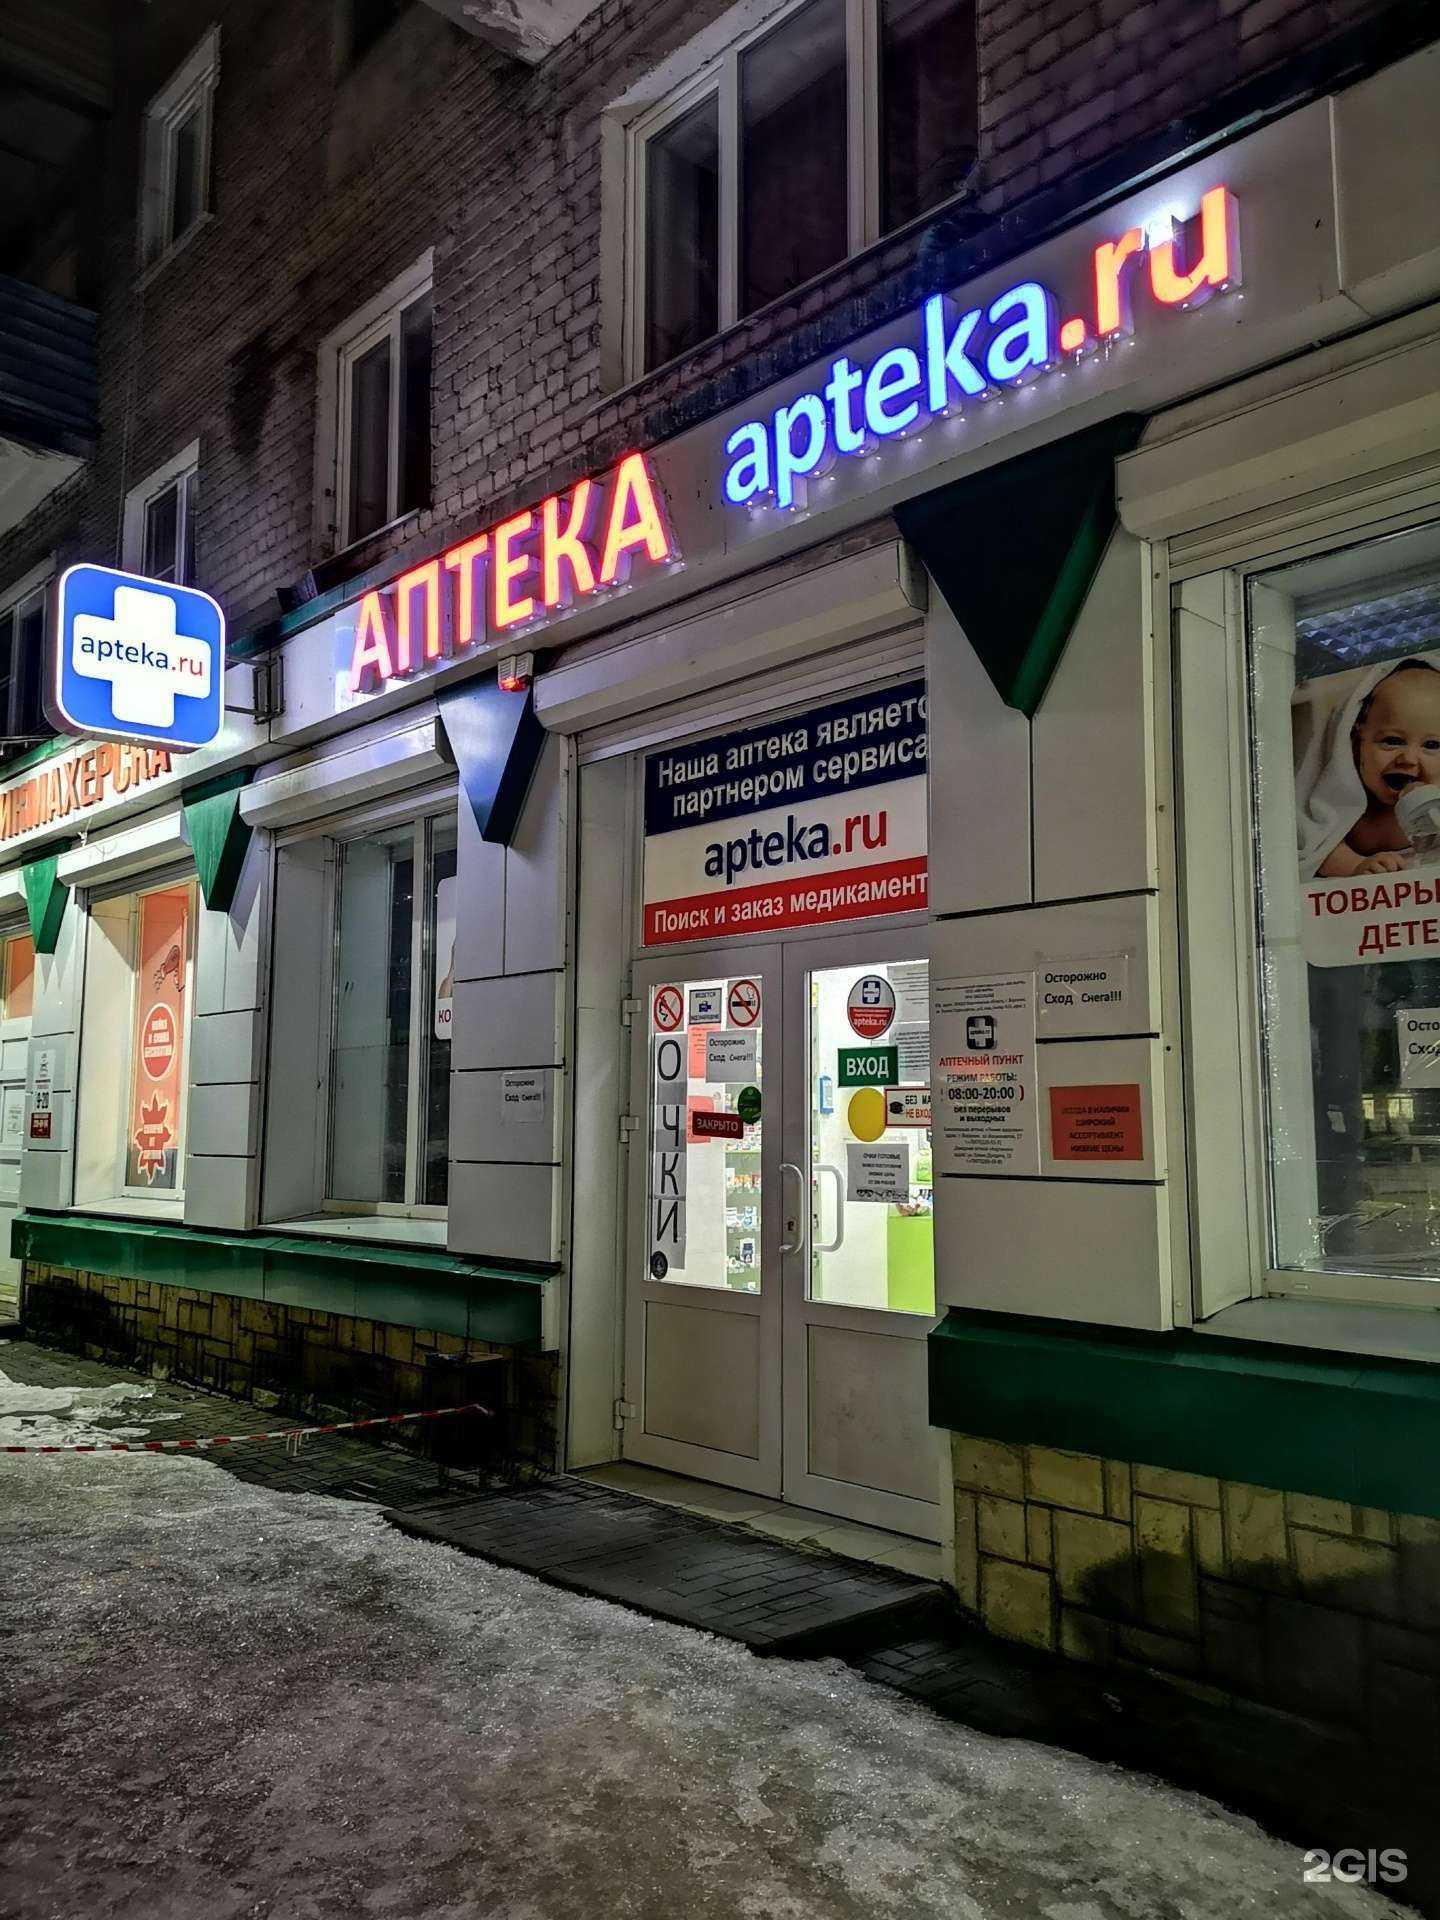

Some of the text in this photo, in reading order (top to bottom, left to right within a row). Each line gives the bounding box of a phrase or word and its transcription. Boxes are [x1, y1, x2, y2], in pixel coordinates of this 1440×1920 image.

[724, 184, 1233, 511] apteka.ru
[350, 451, 671, 695] АПТЕКА
[80, 636, 204, 677] apteka.ru
[658, 753, 719, 788] Наша
[726, 728, 808, 770] аптека
[672, 732, 928, 817] партнером сервиса
[704, 810, 888, 885] apteka.ru
[654, 871, 928, 934] Поиск и заказ медикамент
[1308, 878, 1440, 917] ТОВАРЫ
[1358, 918, 1440, 956] ДЕТЕ
[1044, 972, 1107, 984] Осторожно
[1044, 990, 1122, 1005] Сход Снега!!!
[438, 1009, 452, 1023] КО
[708, 1038, 745, 1047] Осторожно
[708, 1052, 753, 1063] Сход Снега!!!
[939, 1053, 1024, 1067] АПТЕЧНЫЙ ПУНКТ
[846, 1056, 889, 1079] ВХОД
[947, 1074, 977, 1082] РЕЖИМ
[905, 1095, 918, 1105] БЕЗ
[948, 1086, 1015, 1100] 08:00-20:00
[906, 1108, 914, 1118] НЕ
[968, 1106, 1011, 1114] перерывов
[696, 1118, 739, 1132] ЗАКРЫТО
[967, 1115, 1006, 1123] выходных
